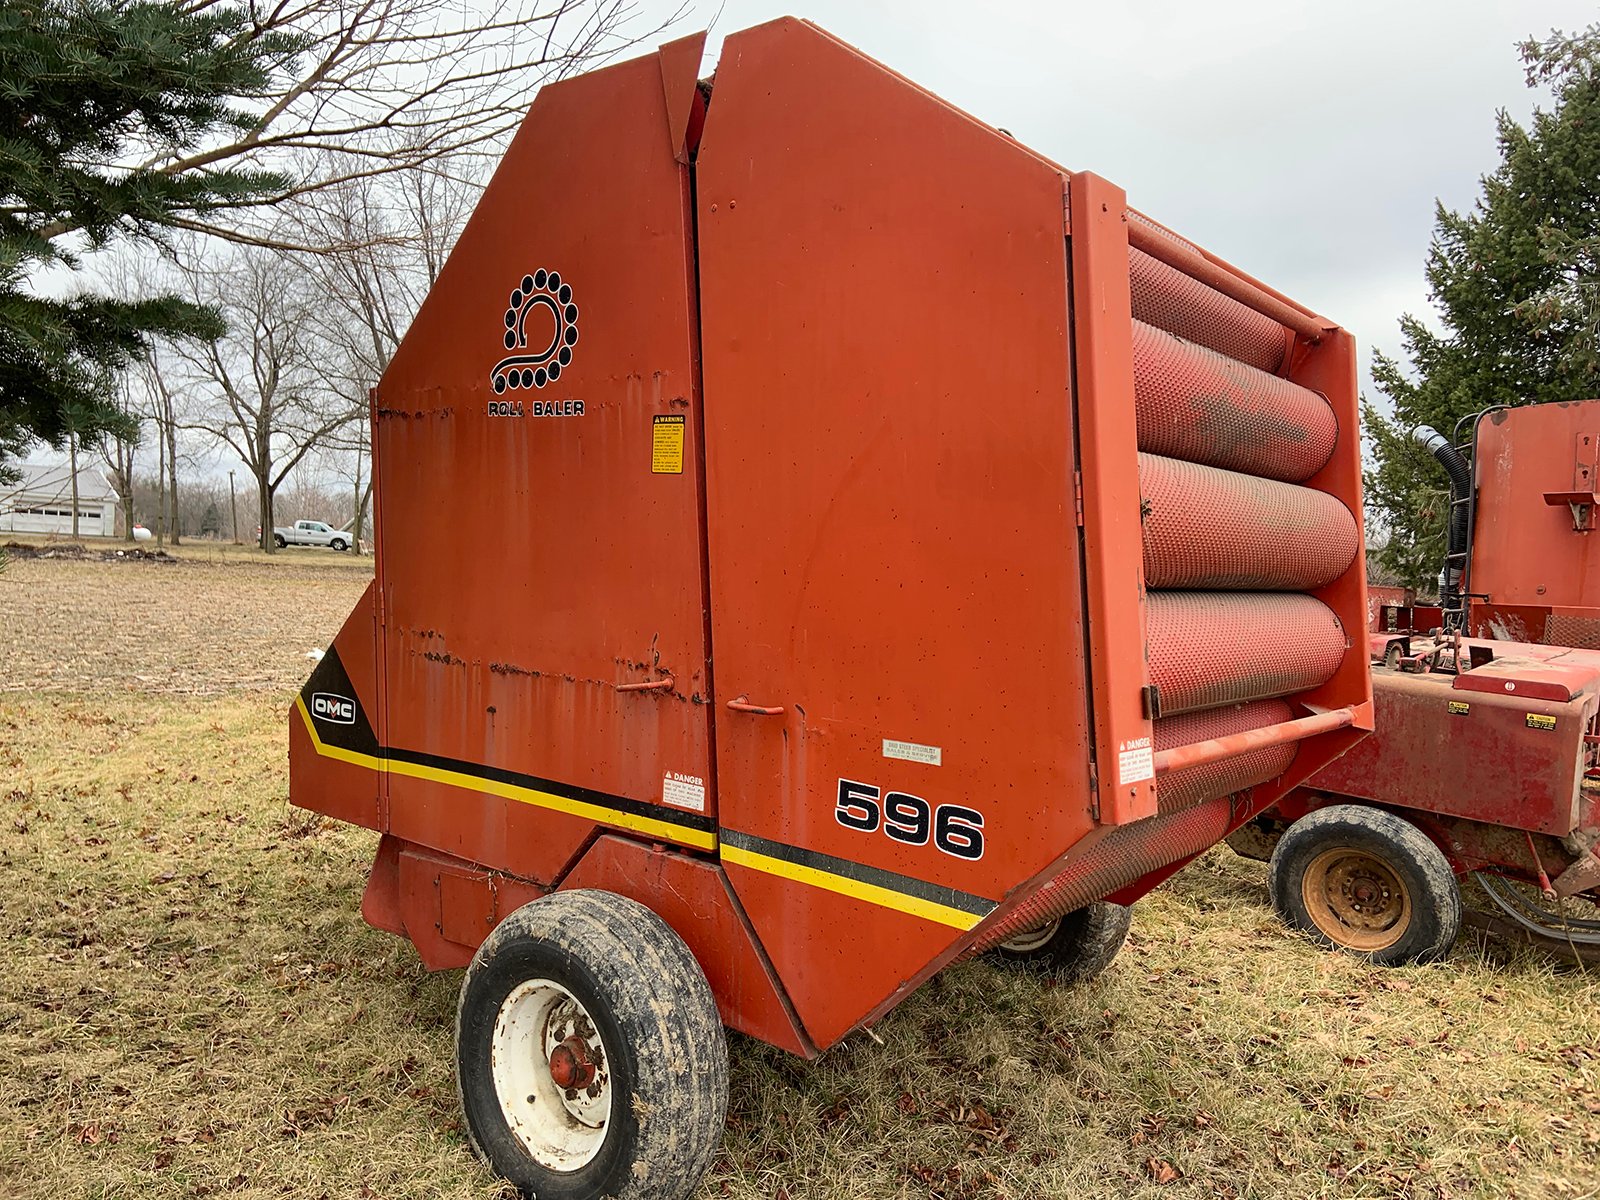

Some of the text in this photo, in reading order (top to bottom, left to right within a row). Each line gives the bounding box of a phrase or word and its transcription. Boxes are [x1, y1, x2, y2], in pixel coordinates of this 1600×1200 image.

[488, 400, 585, 417] ROLL BALER
[315, 698, 352, 718] OMC
[674, 772, 703, 786] DANGER
[835, 778, 984, 861] 596
